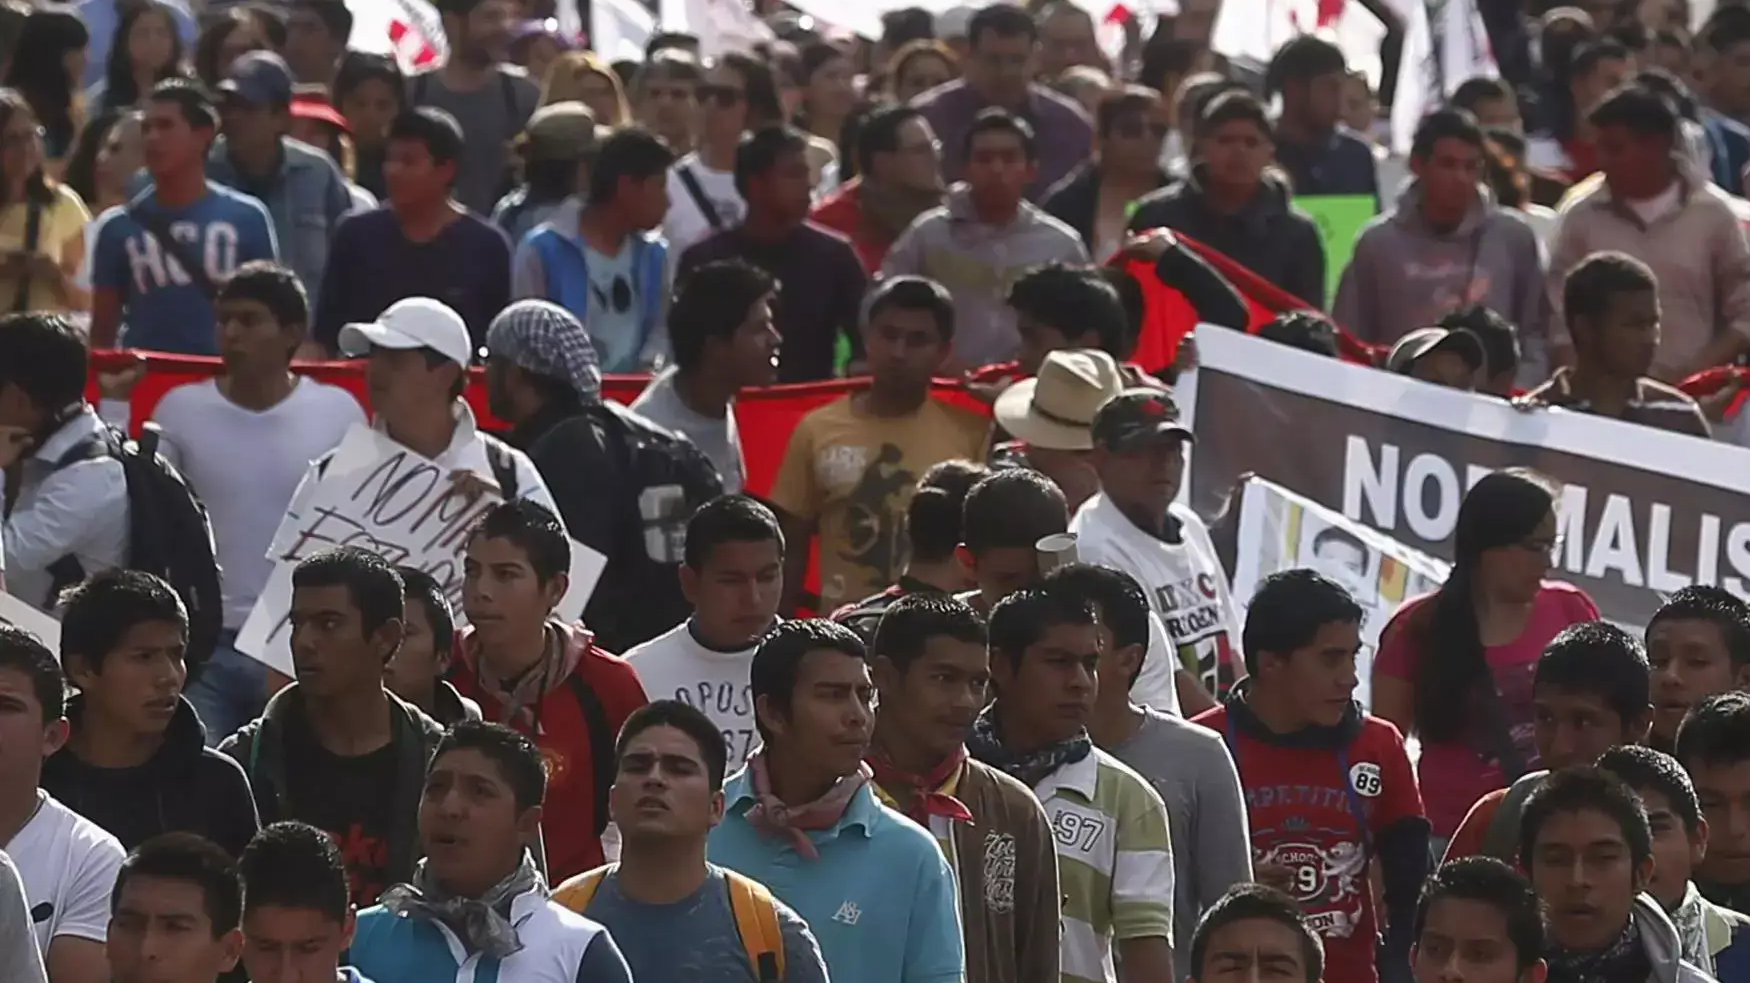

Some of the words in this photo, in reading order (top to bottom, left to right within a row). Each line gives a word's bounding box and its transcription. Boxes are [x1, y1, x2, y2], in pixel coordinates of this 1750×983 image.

[351, 451, 440, 526] NO
[1356, 773, 1380, 794] 89
[1057, 811, 1104, 852] 97
